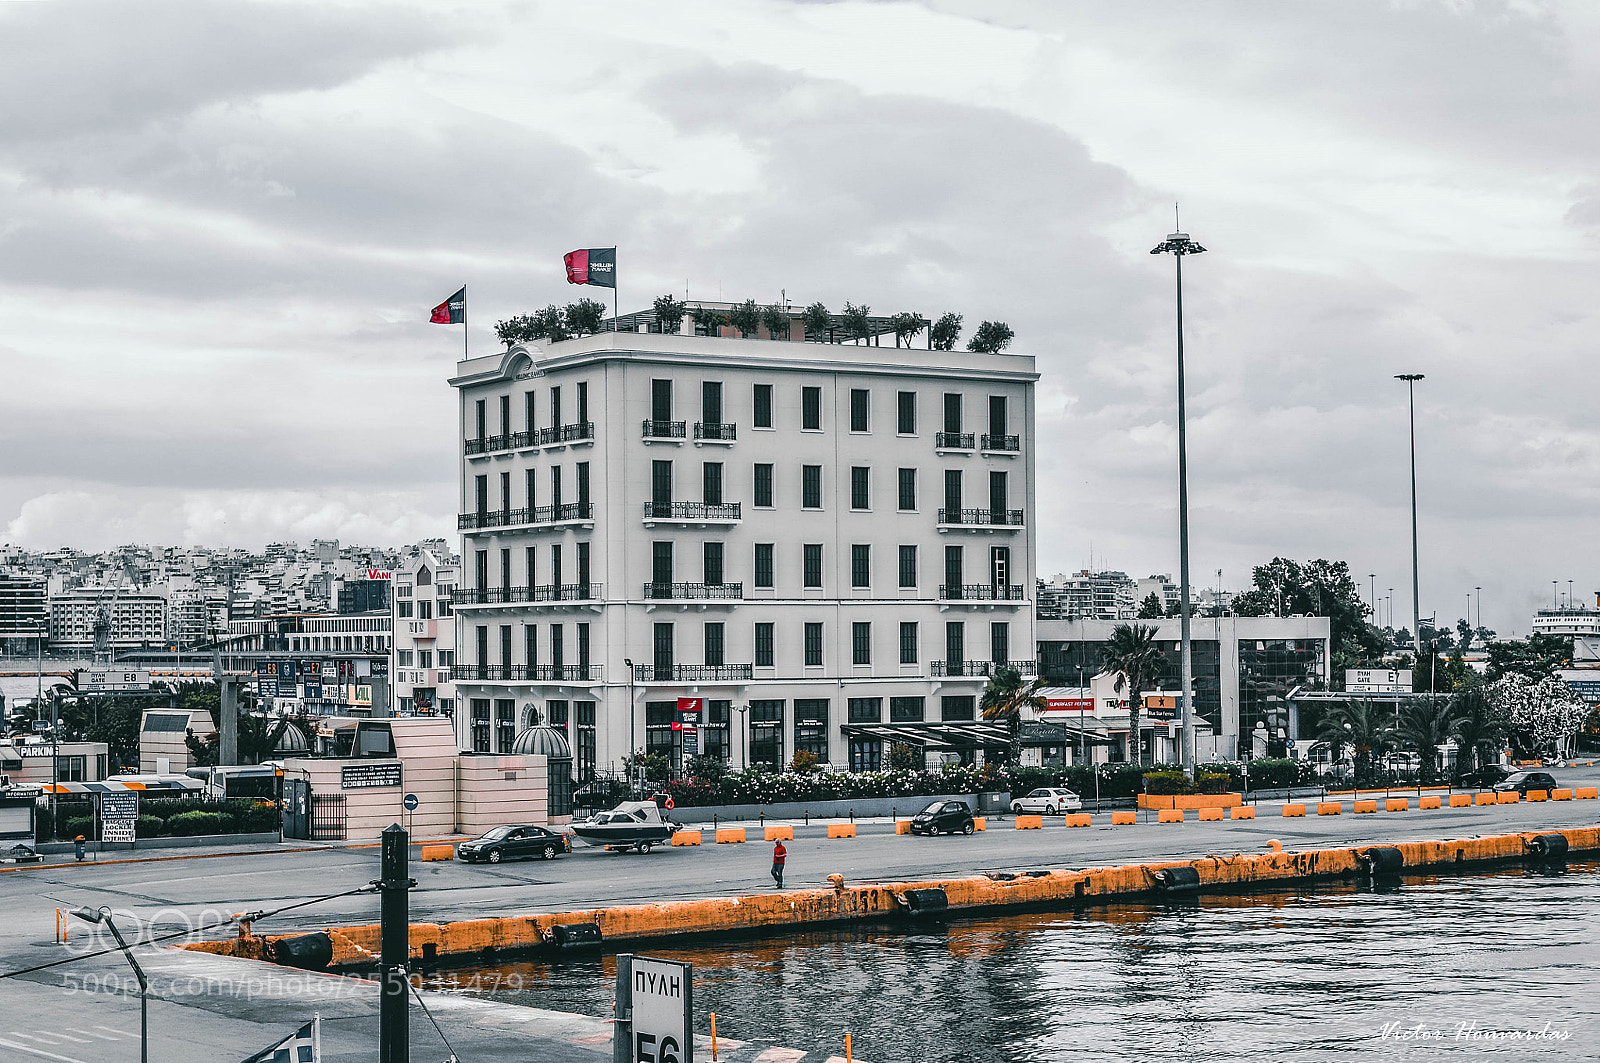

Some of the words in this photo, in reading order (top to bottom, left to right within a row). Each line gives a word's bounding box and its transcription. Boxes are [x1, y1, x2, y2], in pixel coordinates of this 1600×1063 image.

[268, 664, 276, 674] E8
[312, 662, 320, 674] E7
[124, 674, 136, 682] E8
[636, 971, 680, 998] ΠΥΛΗ
[636, 1032, 680, 1063] E6
